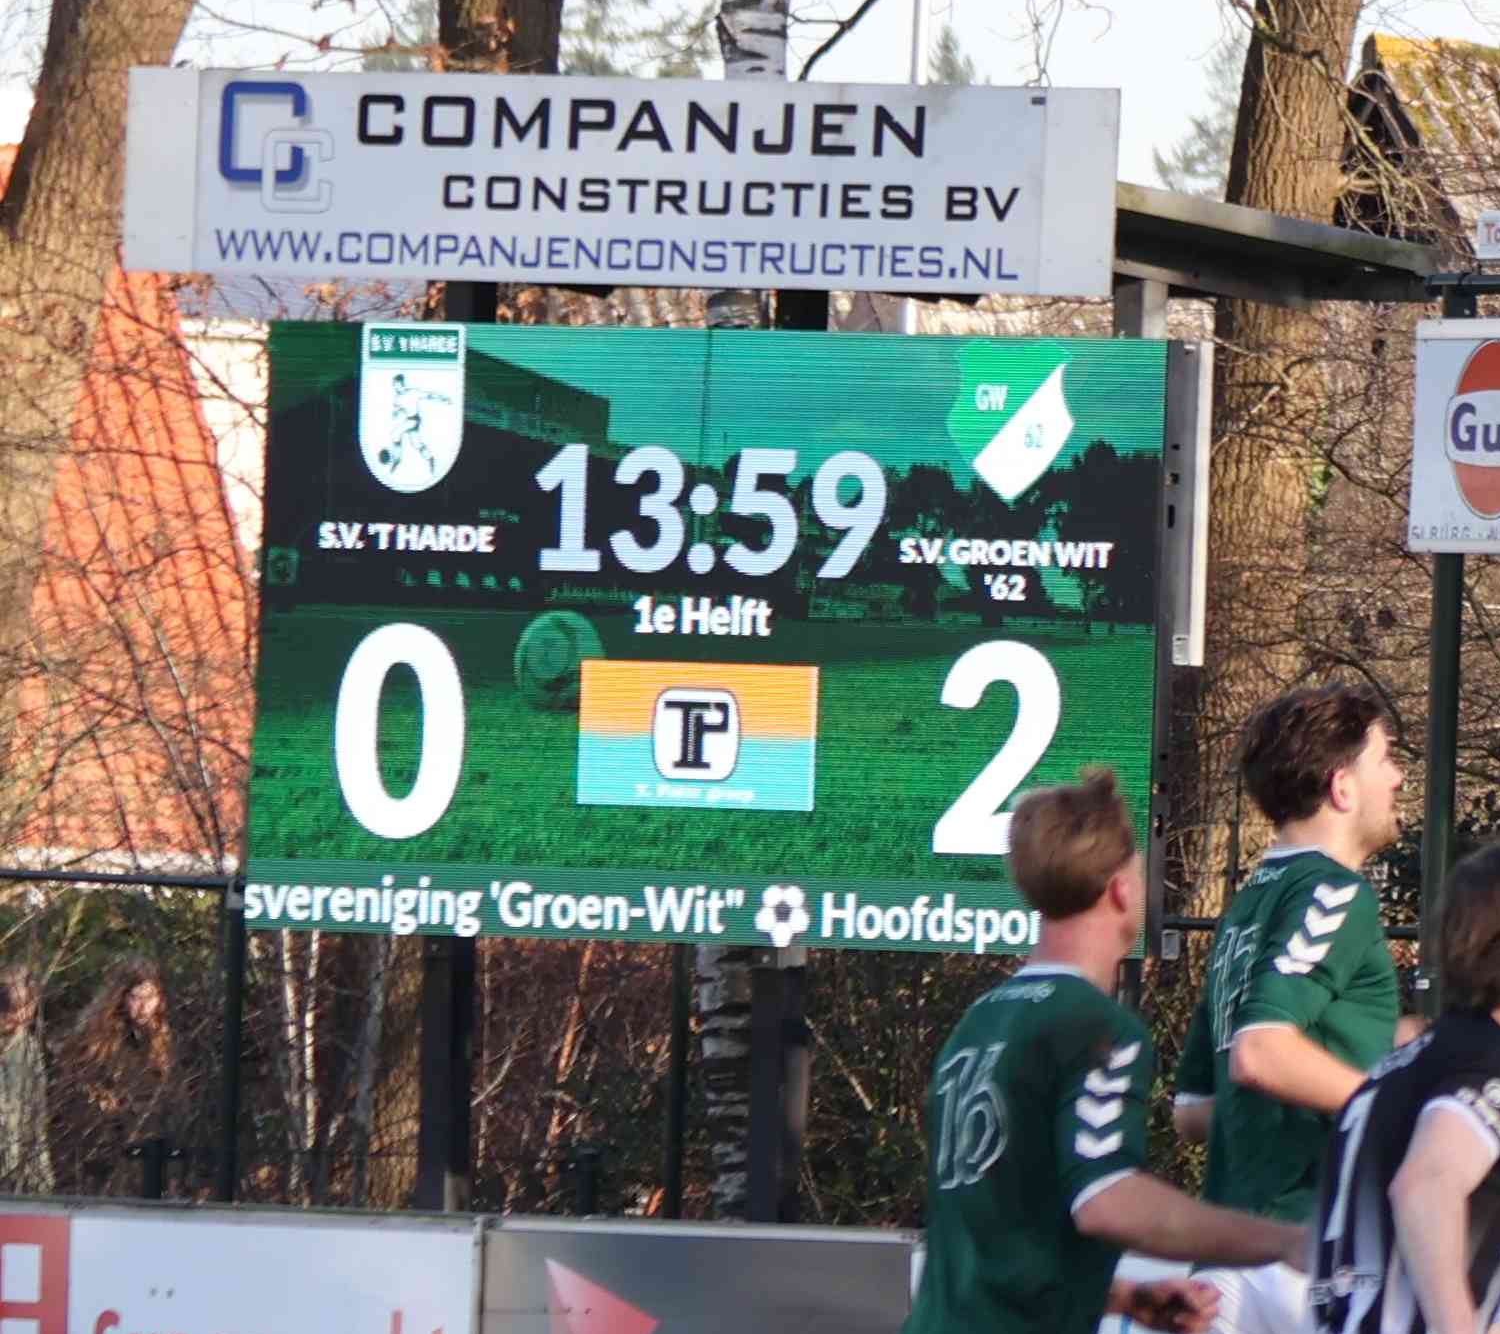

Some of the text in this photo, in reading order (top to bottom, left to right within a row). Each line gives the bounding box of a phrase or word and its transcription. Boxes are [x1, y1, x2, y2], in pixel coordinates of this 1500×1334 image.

[357, 93, 927, 158] COMPANJEN
[442, 174, 1020, 222] CONSTRUCTIES BV
[214, 228, 1019, 281] WWW.COMPANJENCONSTRUCTIES.NL
[975, 383, 1009, 412] GW
[534, 443, 888, 579] 13:59
[318, 521, 367, 550] S.V.
[397, 523, 497, 553] HARDE
[899, 536, 1113, 569] S.V. GROEN WIT
[983, 574, 1026, 602] '62
[634, 595, 773, 637] 1e Helft
[335, 621, 467, 840] 0
[931, 639, 1061, 856] 2
